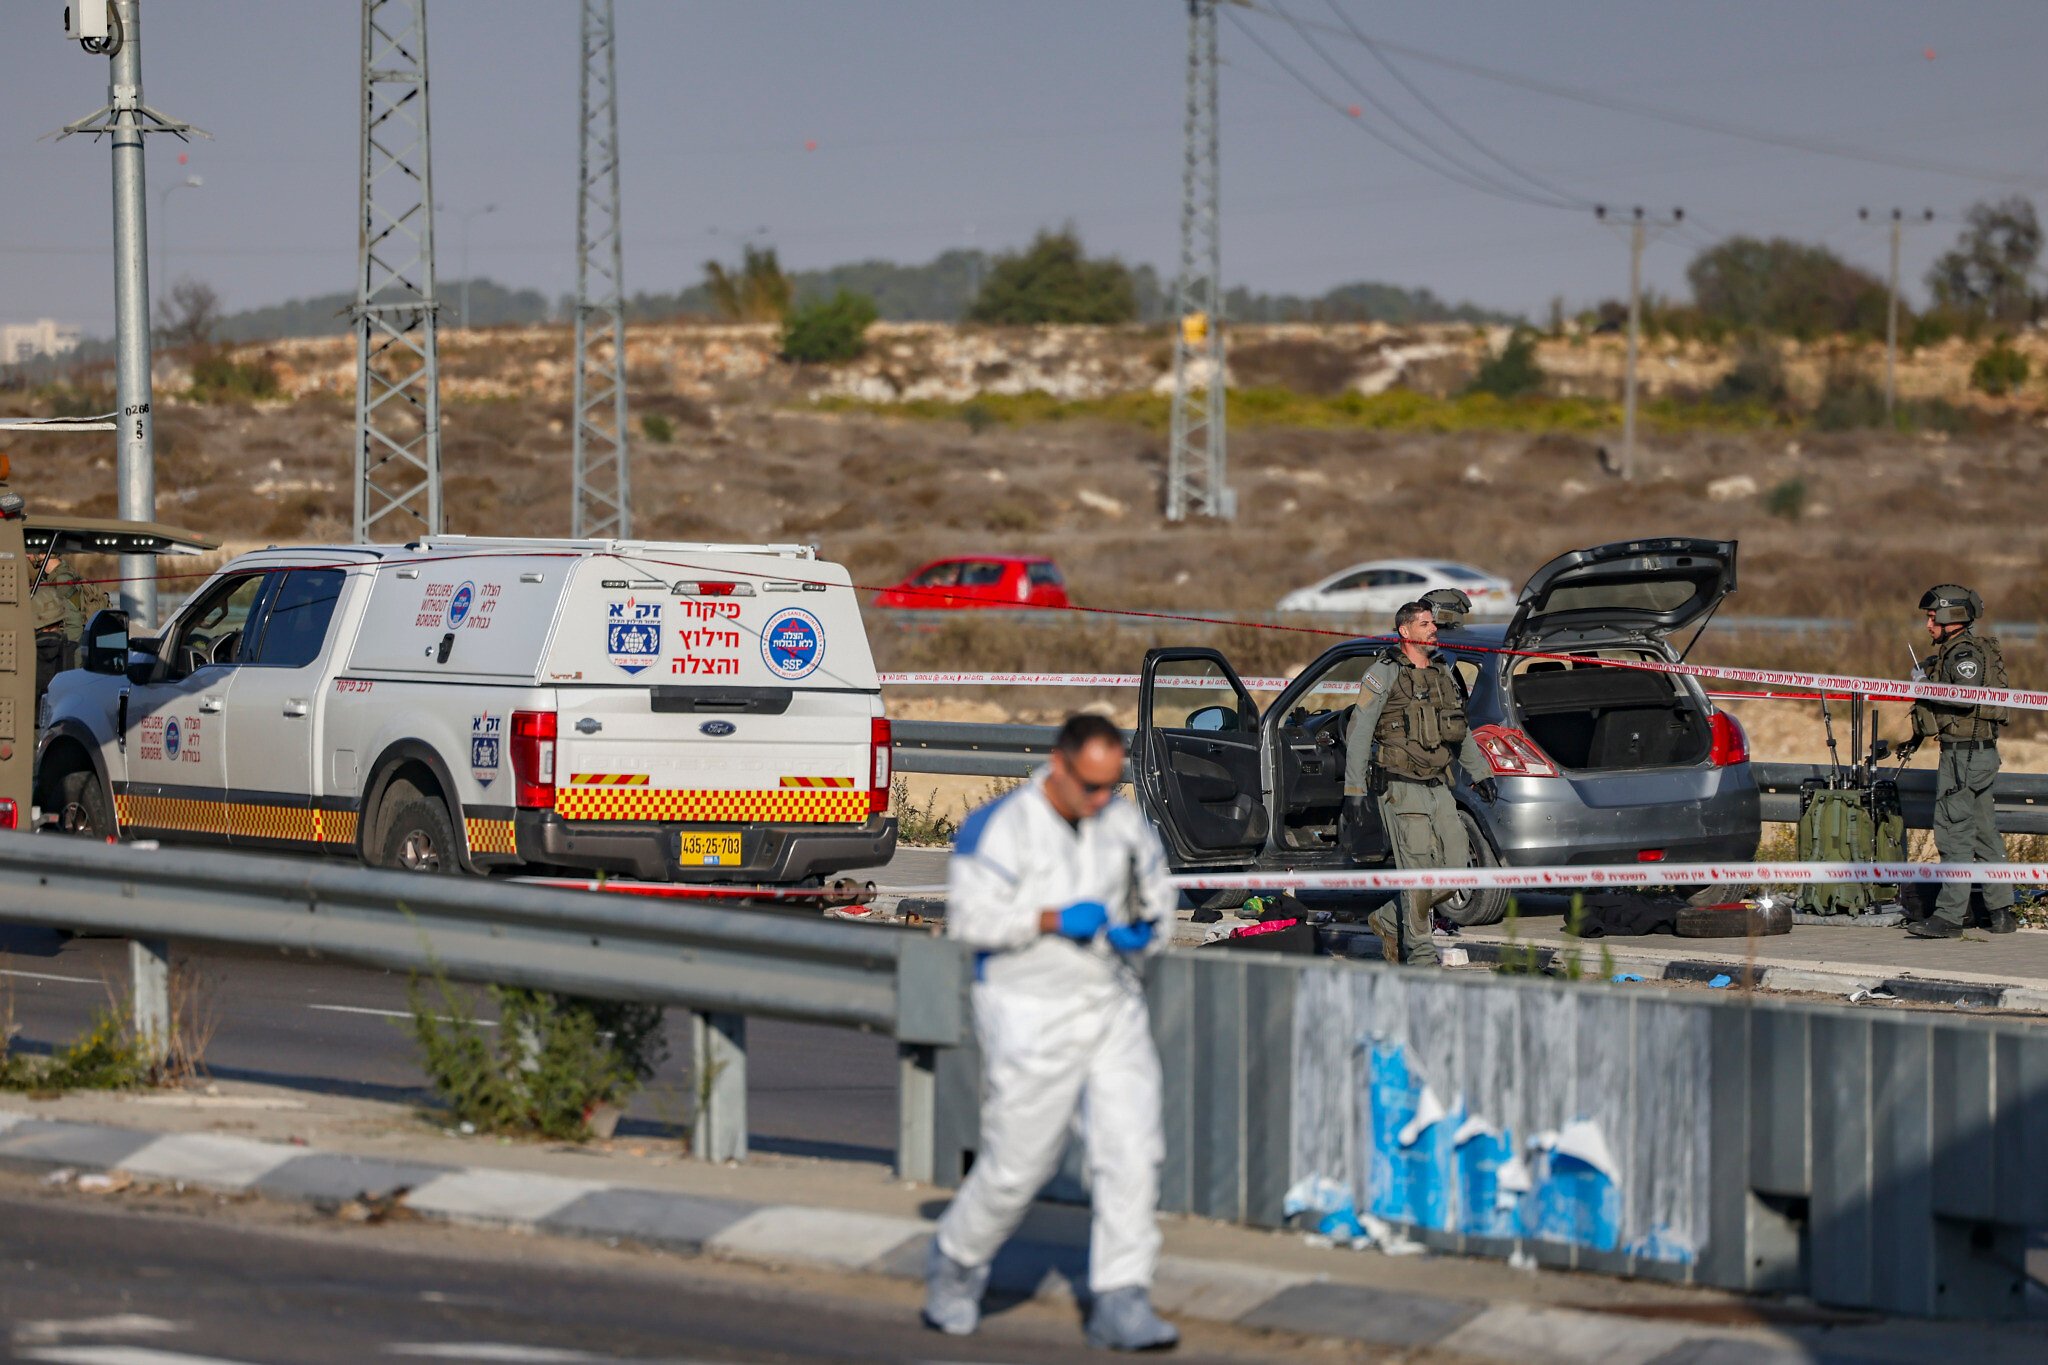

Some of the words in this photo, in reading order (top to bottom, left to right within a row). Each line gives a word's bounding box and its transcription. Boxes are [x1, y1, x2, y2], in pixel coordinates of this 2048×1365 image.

[425, 583, 454, 597] RESCUERS
[481, 582, 501, 597] הצלה
[421, 599, 448, 612] WITHOUT
[480, 600, 497, 613] ללא
[680, 601, 741, 622] פיקוד
[415, 614, 442, 627] BORDERS
[467, 615, 491, 629] גבולות
[679, 626, 739, 650] חילוץ
[783, 631, 804, 640] הצלה
[772, 639, 797, 648] גבולות
[798, 639, 813, 648] ללא
[672, 654, 739, 674] והצלה
[782, 659, 803, 670] SSF
[1732, 670, 1756, 681] משטרת
[1766, 673, 1784, 684] מעבר
[1783, 674, 1793, 686] אין
[1794, 673, 1814, 686] ישראל
[336, 681, 357, 693] פיקוד
[357, 681, 373, 692] רכב
[1826, 678, 1851, 689] משטרת
[1862, 680, 1880, 692] מעבר
[1879, 681, 1889, 693] אין
[1889, 680, 1910, 694] ישראל
[1923, 685, 1948, 698] משטרת
[1959, 688, 1977, 700] מעבר
[1976, 689, 1988, 702] אין
[1988, 689, 2009, 702] ישראל
[1556, 872, 1588, 882] ישראל
[1608, 872, 1647, 881] משטרת
[1661, 871, 1689, 880] מעבר
[1691, 871, 1705, 881] אין
[1722, 868, 1754, 878] ישראל
[1774, 869, 1812, 878] משטרת
[1825, 870, 1852, 878] מעבר
[1854, 870, 1868, 880] אין
[1885, 868, 1916, 877] ישראל
[1935, 869, 1971, 878] משטרת
[1985, 870, 2011, 878] מעבר
[2012, 870, 2026, 880] אין
